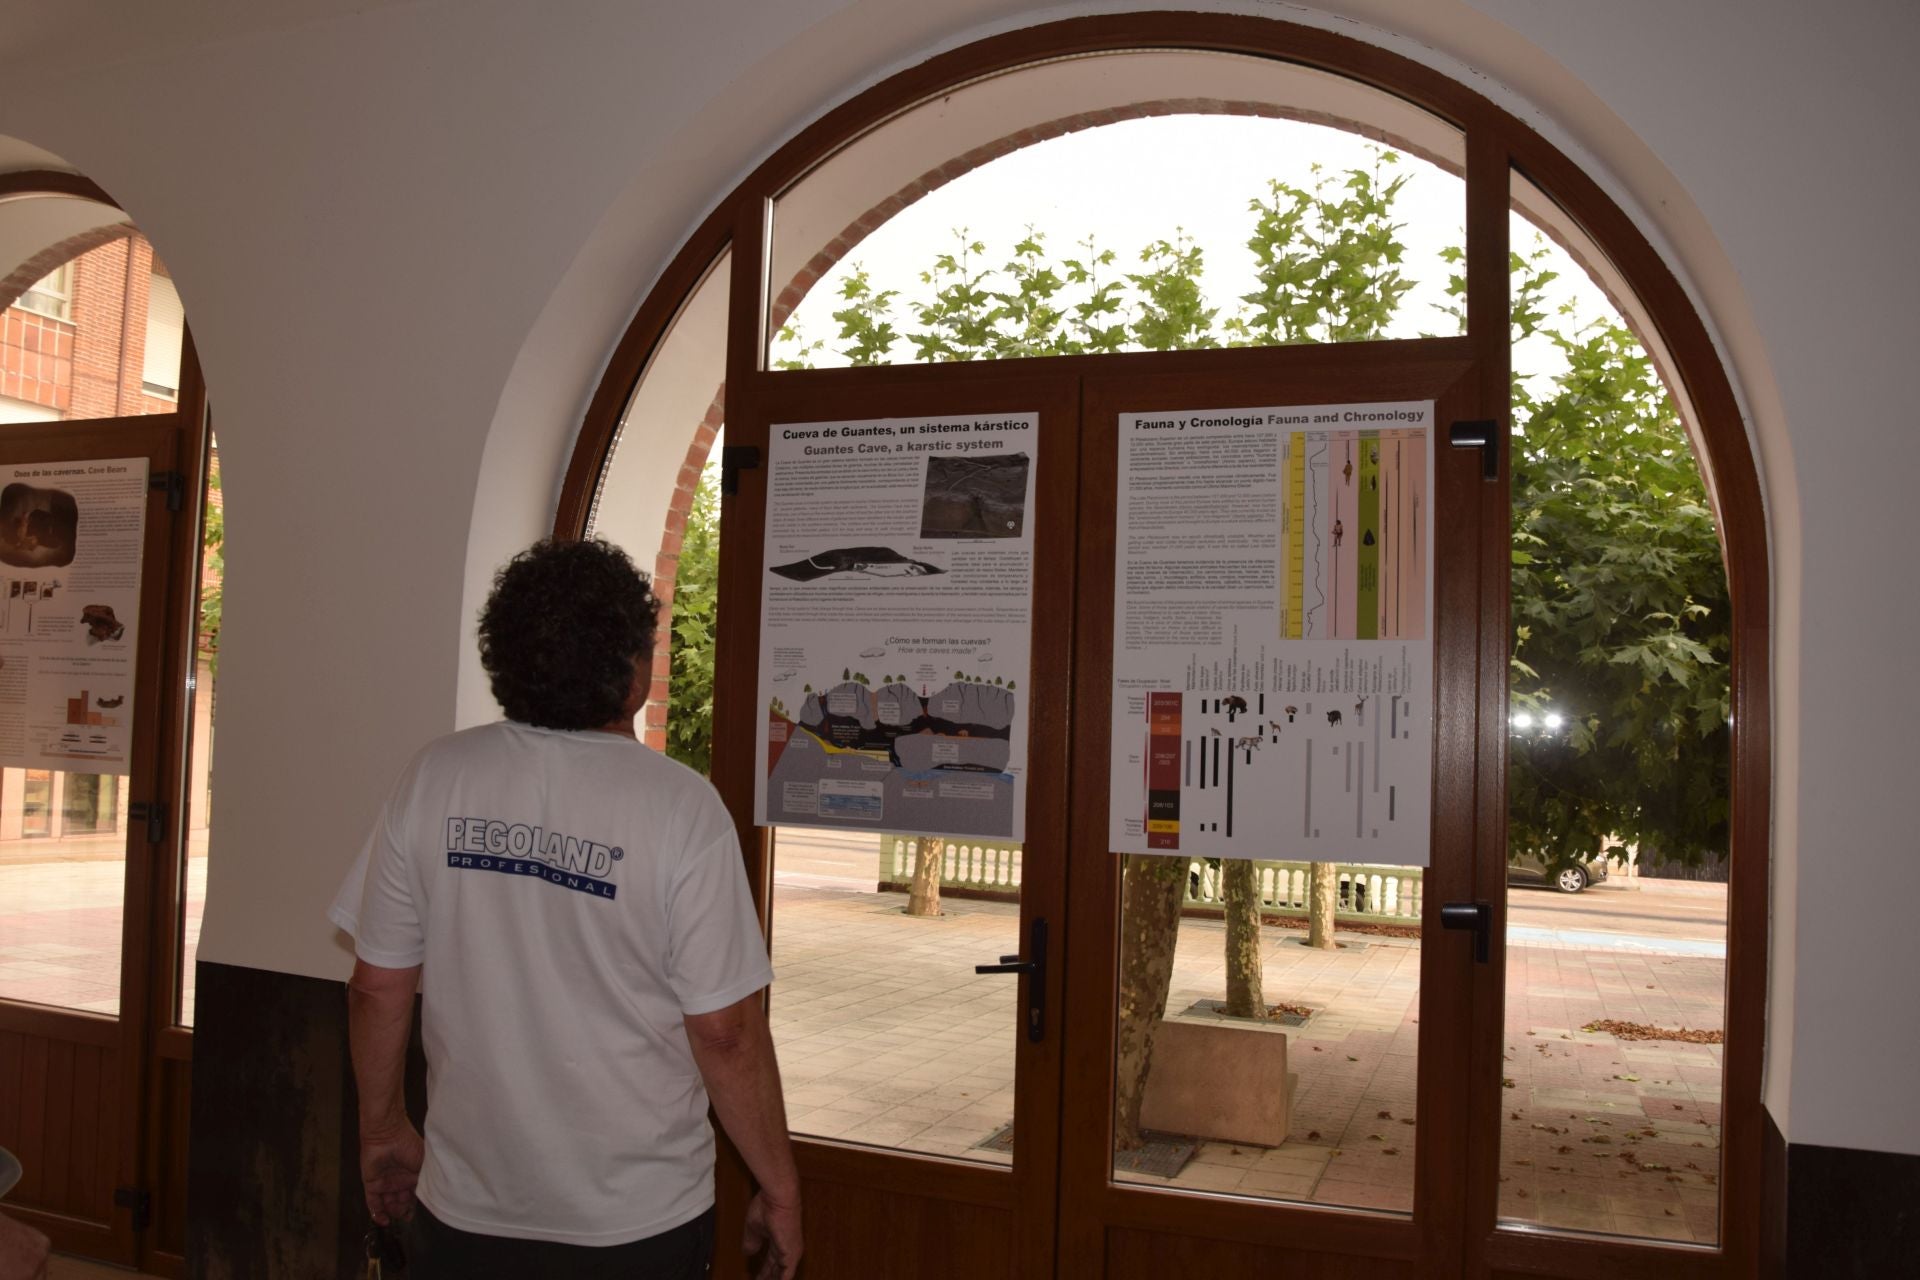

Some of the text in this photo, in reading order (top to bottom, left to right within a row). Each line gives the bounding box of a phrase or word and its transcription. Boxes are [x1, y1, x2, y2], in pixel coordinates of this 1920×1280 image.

[783, 420, 1029, 440] Cueva de Guantes, un sistema kárstico
[1135, 419, 1175, 430] Fauna
[1178, 420, 1186, 431] y
[1267, 414, 1309, 425] Fauna
[1313, 412, 1339, 423] and
[1343, 410, 1424, 422] Chronology
[804, 440, 1004, 456] Guantes Cave, a karstic system
[450, 856, 612, 897] PROFESIONAL
